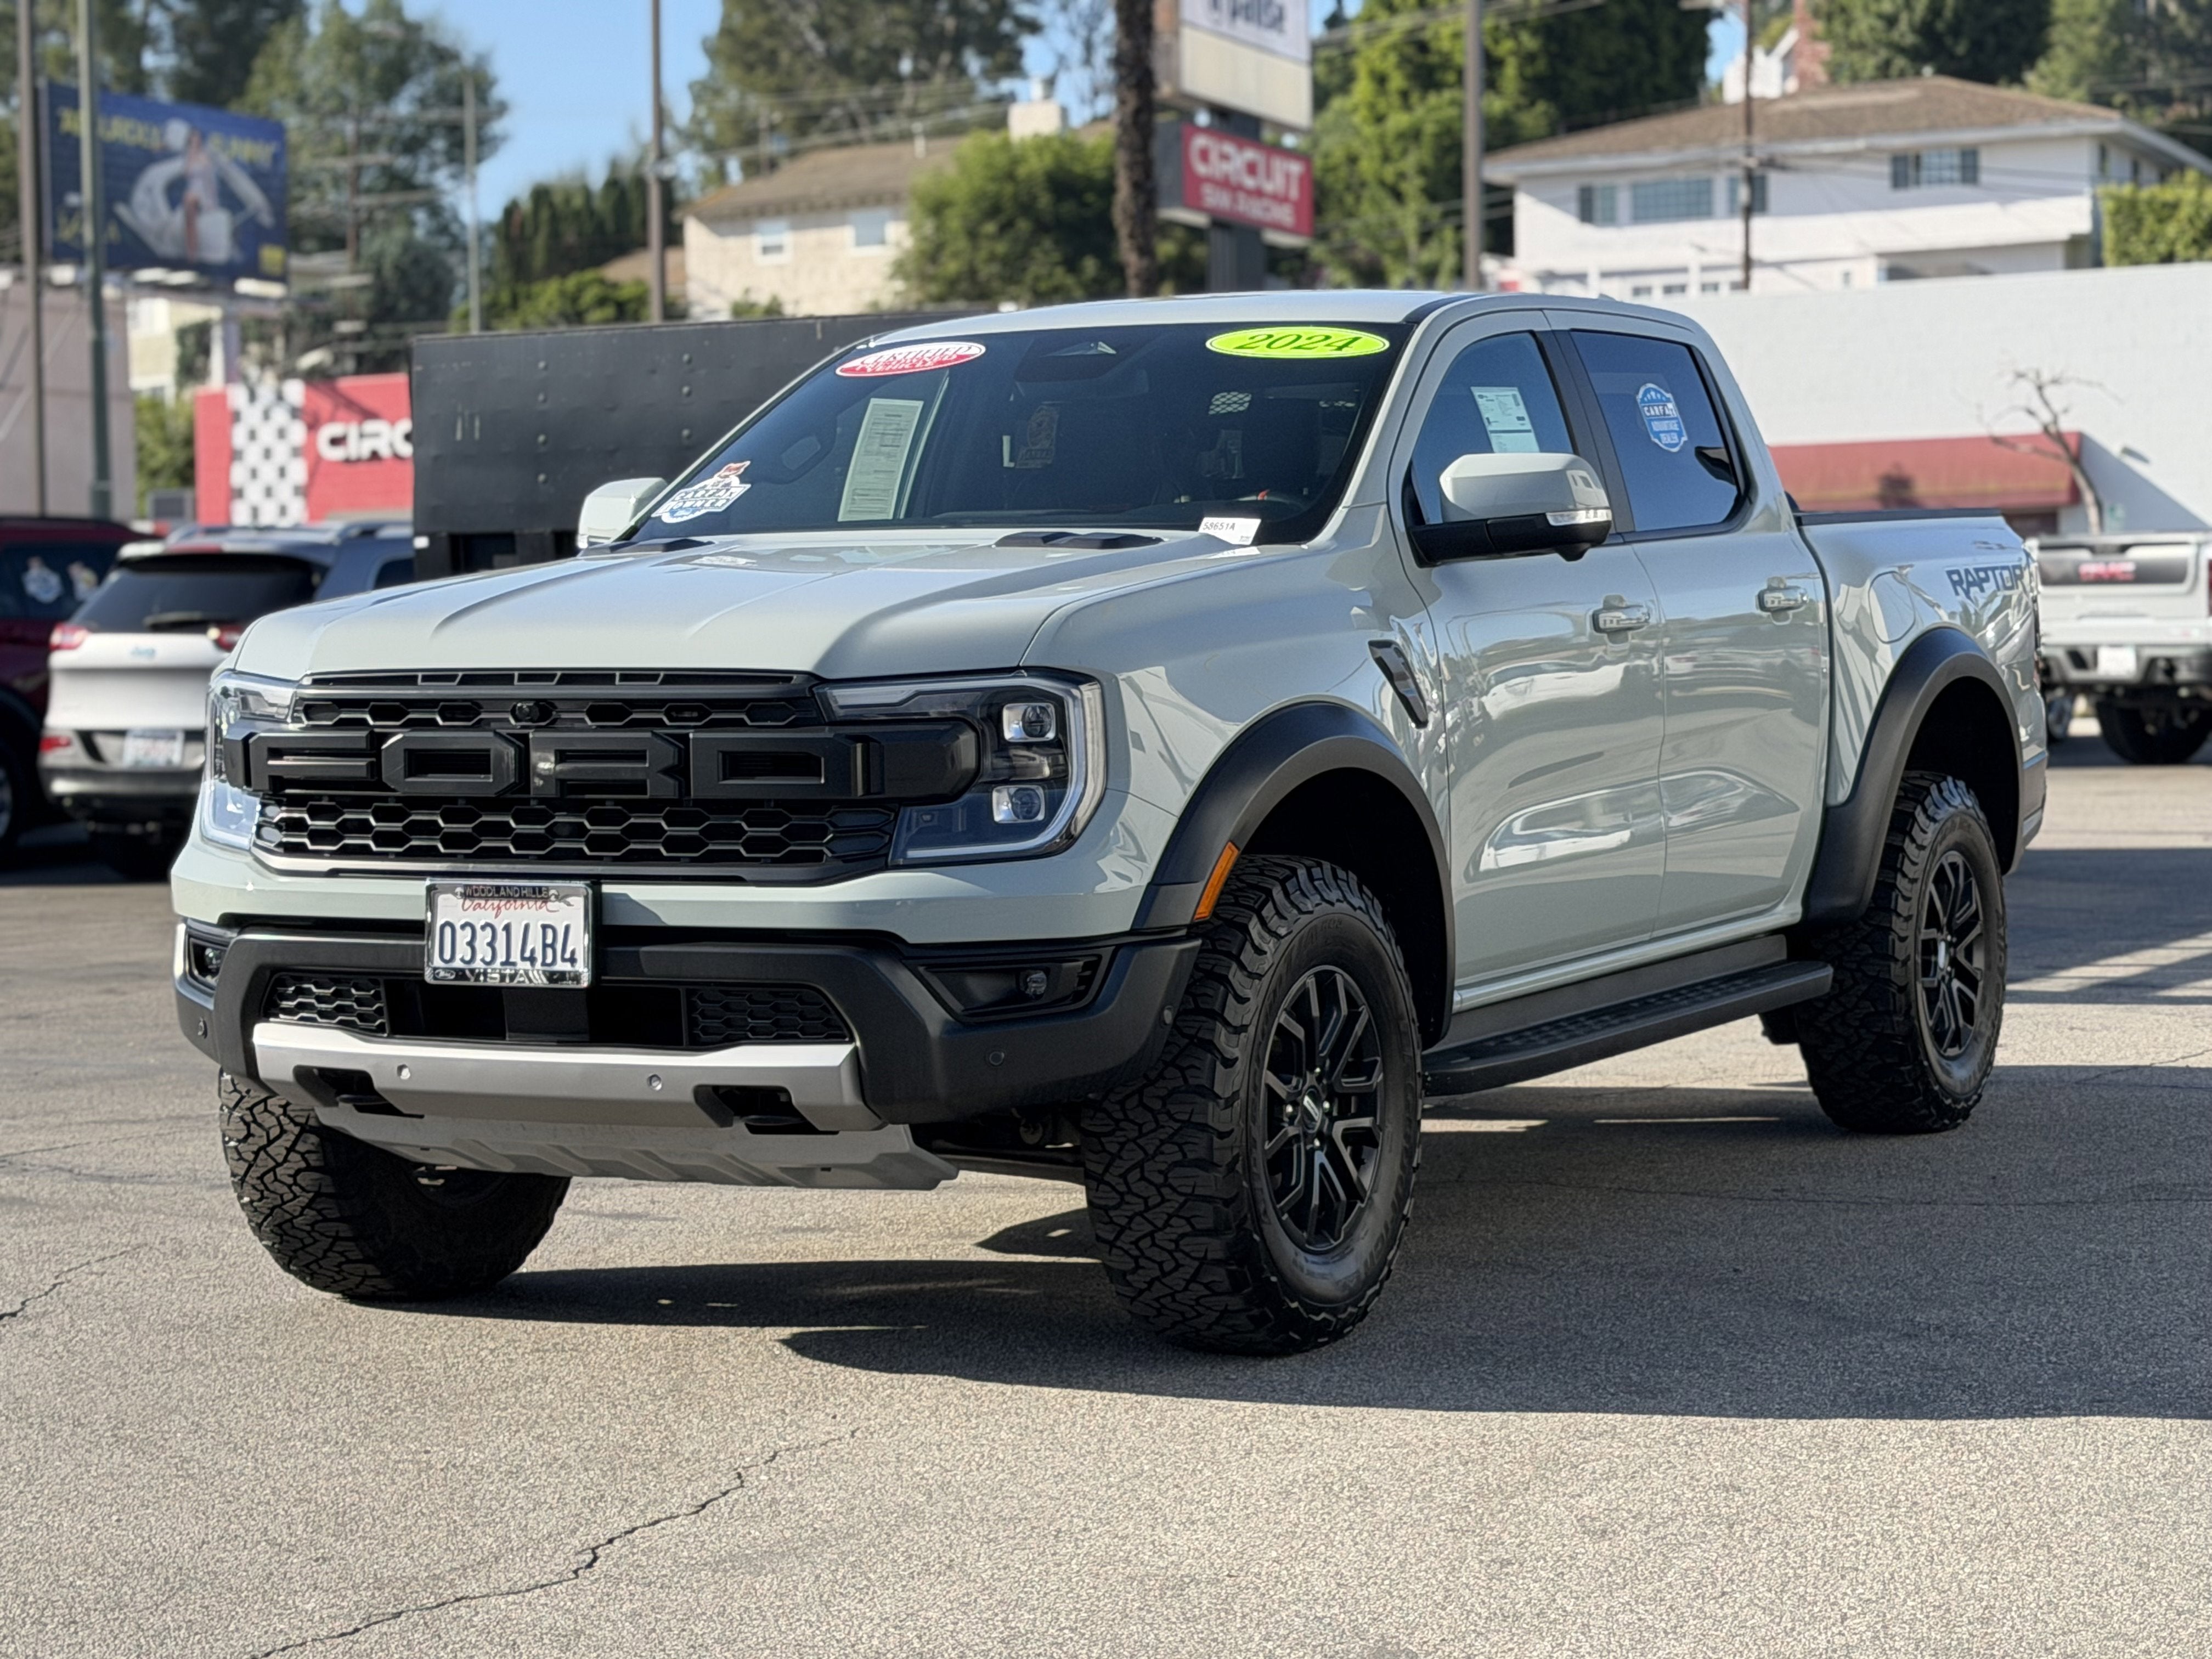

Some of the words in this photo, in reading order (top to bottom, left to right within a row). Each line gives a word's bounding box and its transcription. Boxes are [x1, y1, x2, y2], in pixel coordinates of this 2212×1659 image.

[1189, 136, 1305, 201] CIRCUIT
[1233, 334, 1362, 351] 2024
[1644, 404, 1678, 417] CARFAX
[1945, 564, 2028, 603] RAPTOR
[247, 730, 860, 800] FORD
[466, 886, 521, 897] WOODLAND
[522, 887, 548, 898] HILLS
[462, 899, 560, 919] California
[438, 920, 578, 968] 03314B4
[466, 969, 531, 984] VISTA
